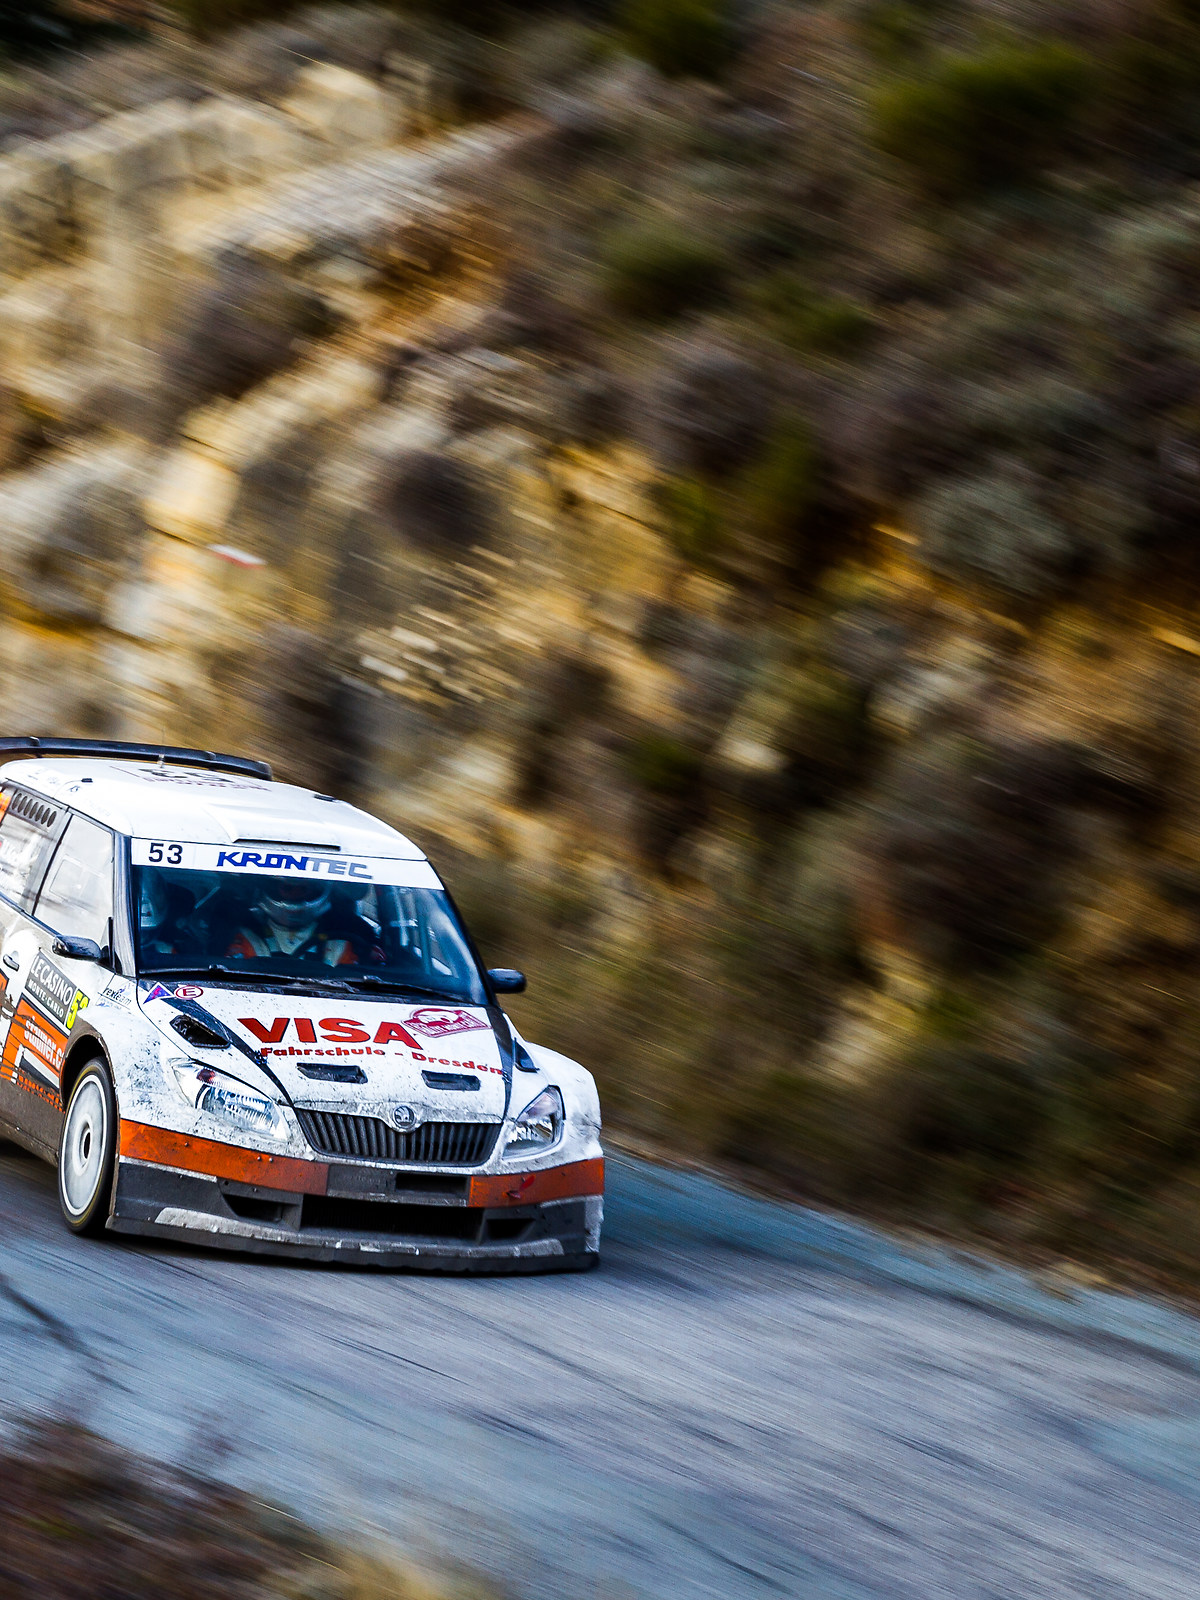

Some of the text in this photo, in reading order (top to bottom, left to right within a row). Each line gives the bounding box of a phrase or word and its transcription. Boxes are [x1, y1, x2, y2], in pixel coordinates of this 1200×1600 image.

[148, 842, 184, 865] 53
[216, 851, 373, 880] KRONTEC
[237, 1017, 423, 1050] VISA
[261, 1045, 386, 1058] Fahrschule
[411, 1051, 503, 1075] Dresden
